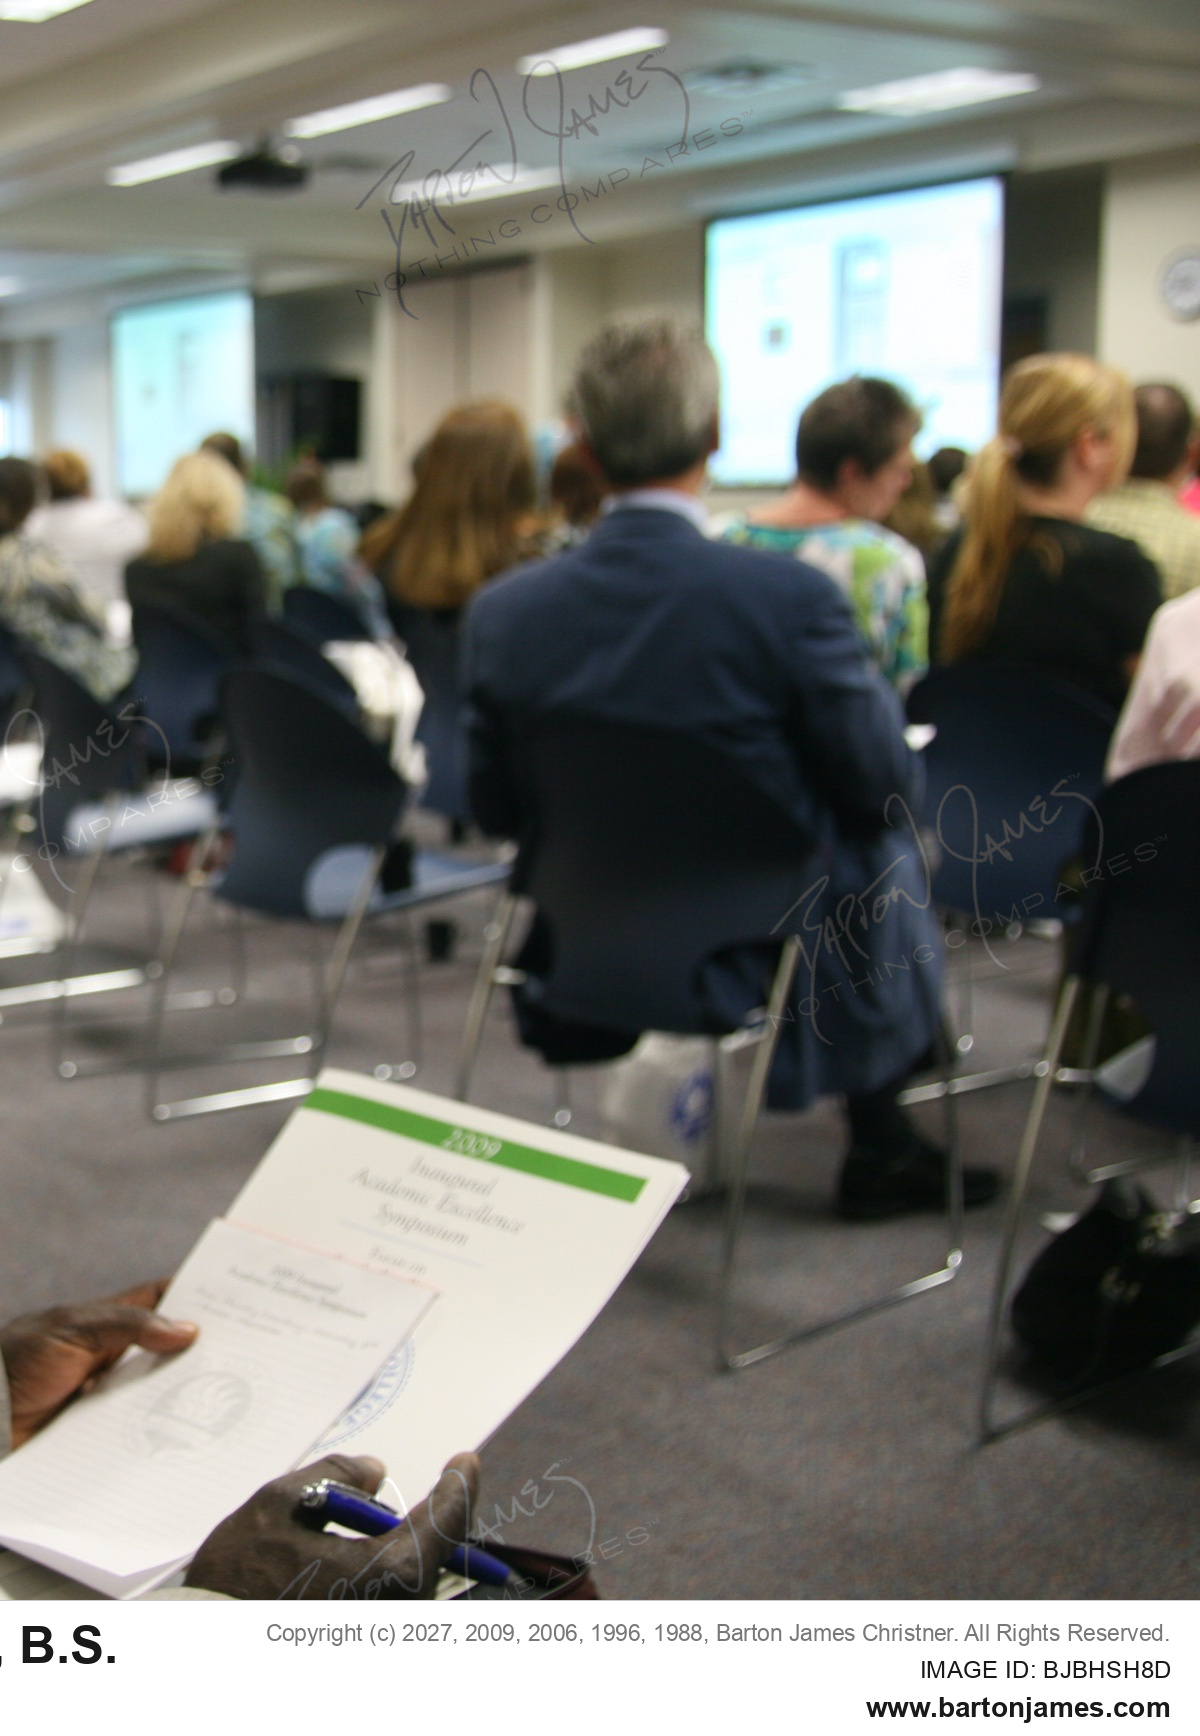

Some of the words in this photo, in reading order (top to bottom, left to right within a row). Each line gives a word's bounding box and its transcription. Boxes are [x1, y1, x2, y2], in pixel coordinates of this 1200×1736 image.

[440, 1127, 503, 1160] 2009
[408, 1154, 499, 1197] Inaugural
[350, 1166, 430, 1207] Academic
[436, 1193, 526, 1234] Excellence
[376, 1202, 470, 1246] Symposium
[342, 1353, 401, 1427] OLLEGE
